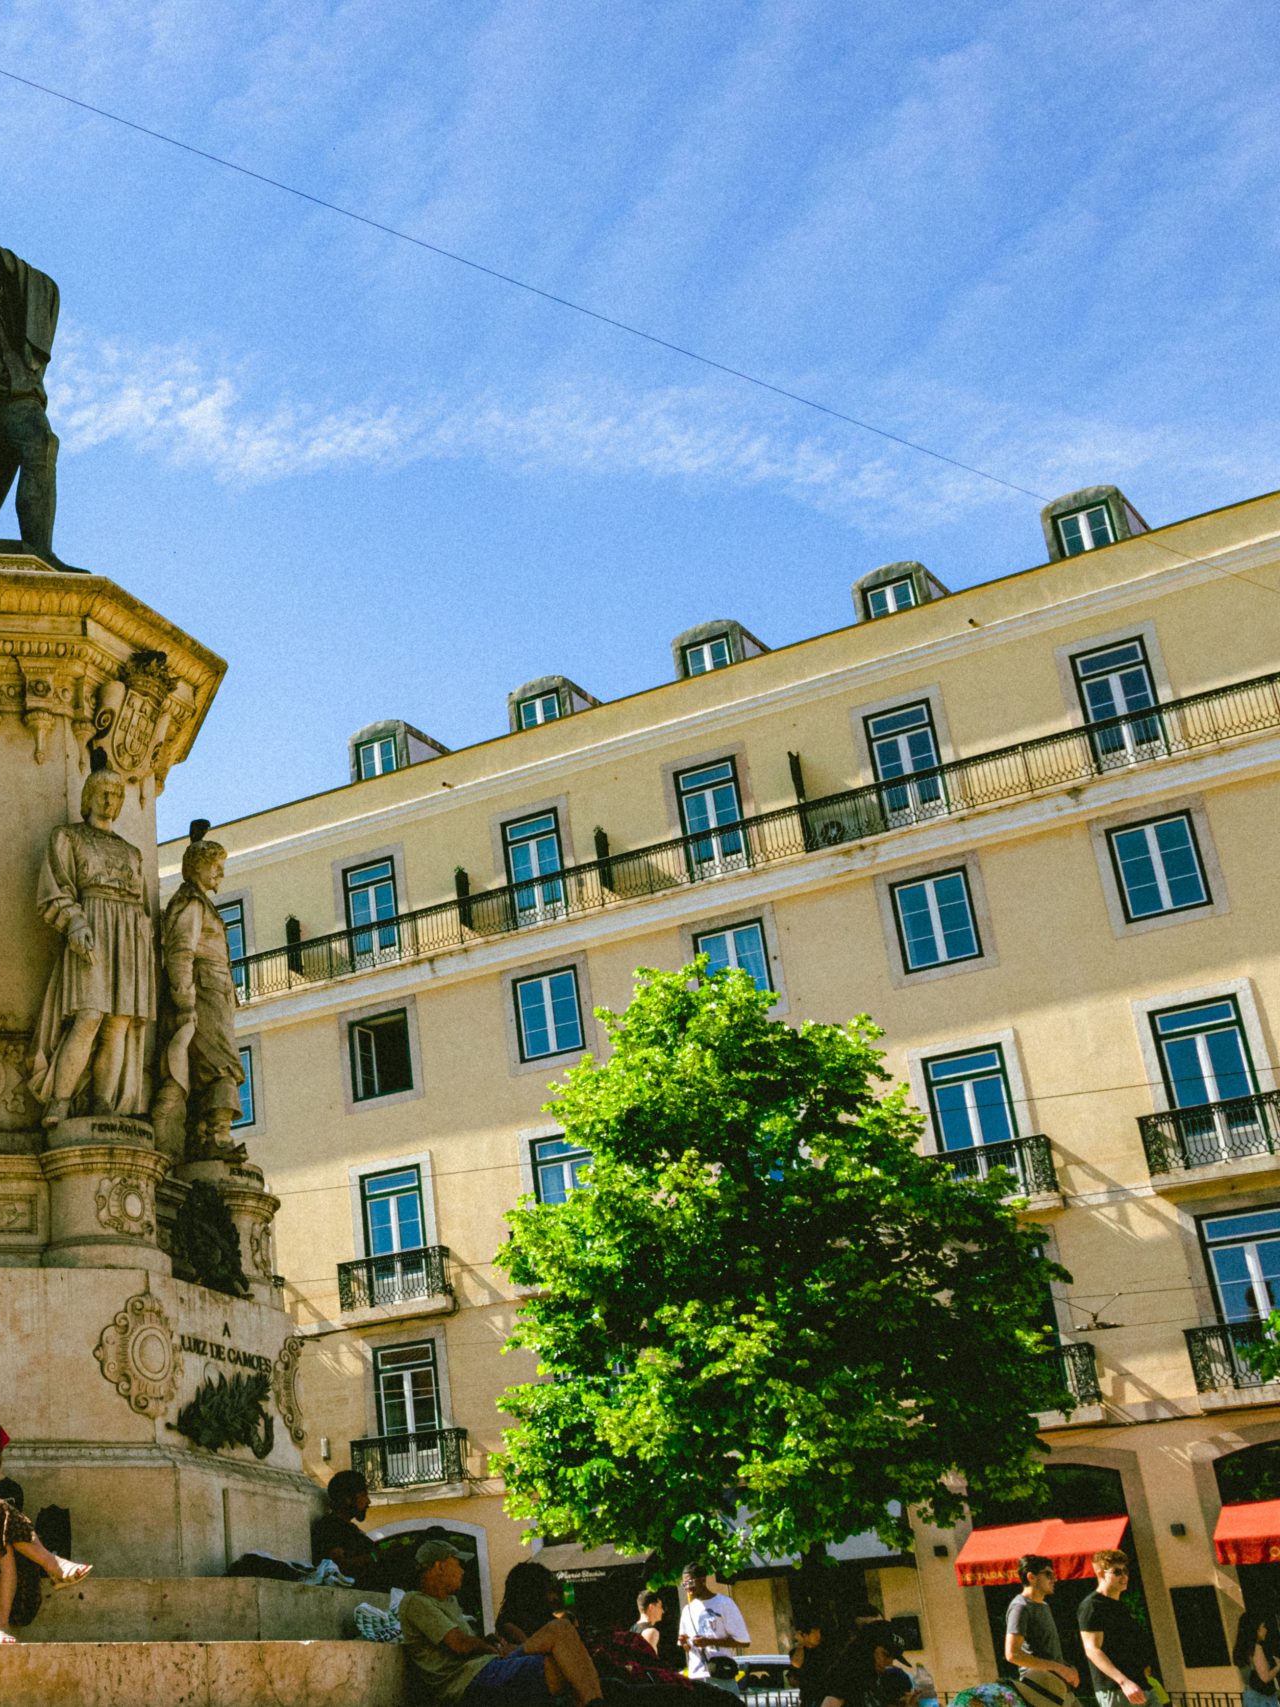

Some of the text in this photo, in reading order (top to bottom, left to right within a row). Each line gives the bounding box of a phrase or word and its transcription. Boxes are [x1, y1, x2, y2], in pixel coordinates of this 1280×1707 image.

[222, 1321, 232, 1338] A
[180, 1334, 208, 1356] LUIZ
[208, 1341, 226, 1362] DE
